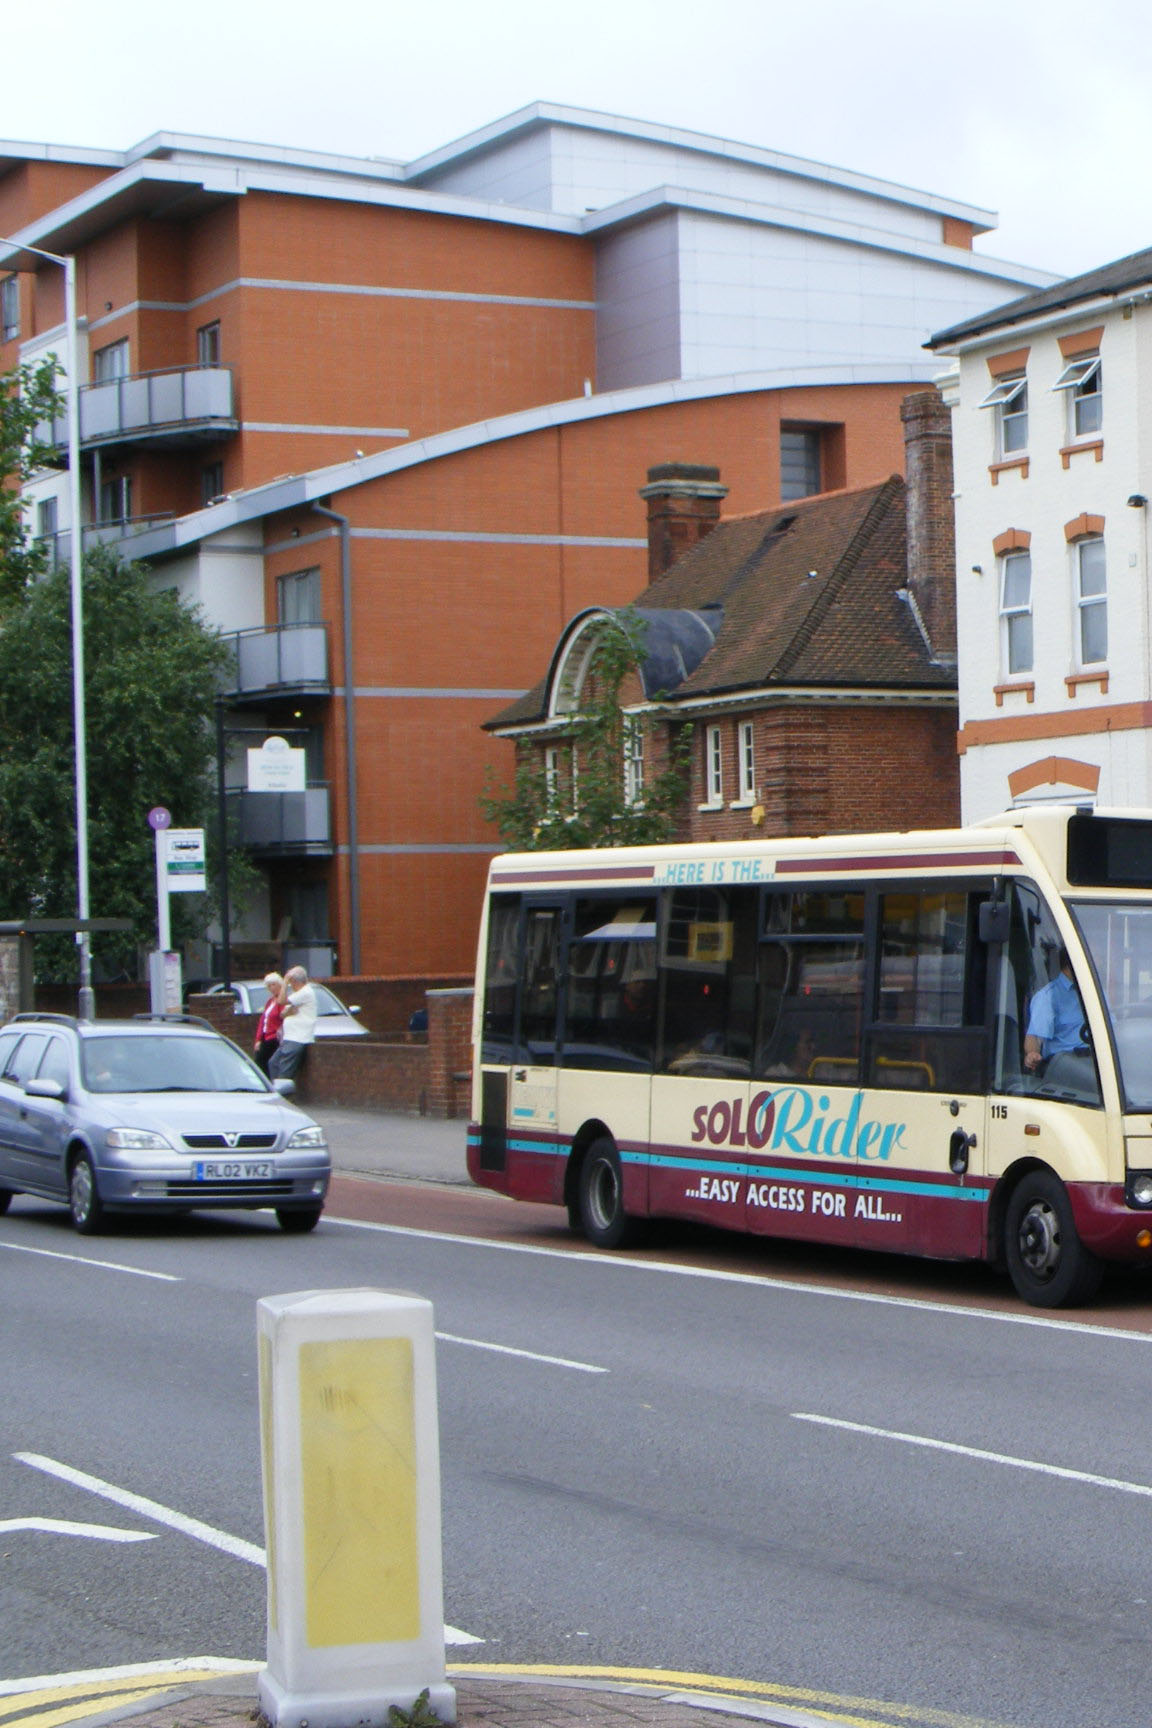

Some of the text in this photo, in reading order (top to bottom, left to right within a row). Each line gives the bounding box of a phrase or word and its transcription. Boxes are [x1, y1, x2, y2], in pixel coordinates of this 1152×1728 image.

[711, 861, 725, 881] IS
[991, 1105, 1008, 1119] 115
[691, 1086, 908, 1160] SOLO Rider
[206, 1163, 269, 1177] RL02 VKZ
[746, 1182, 805, 1213] ACCESS
[812, 1190, 846, 1217] FOR
